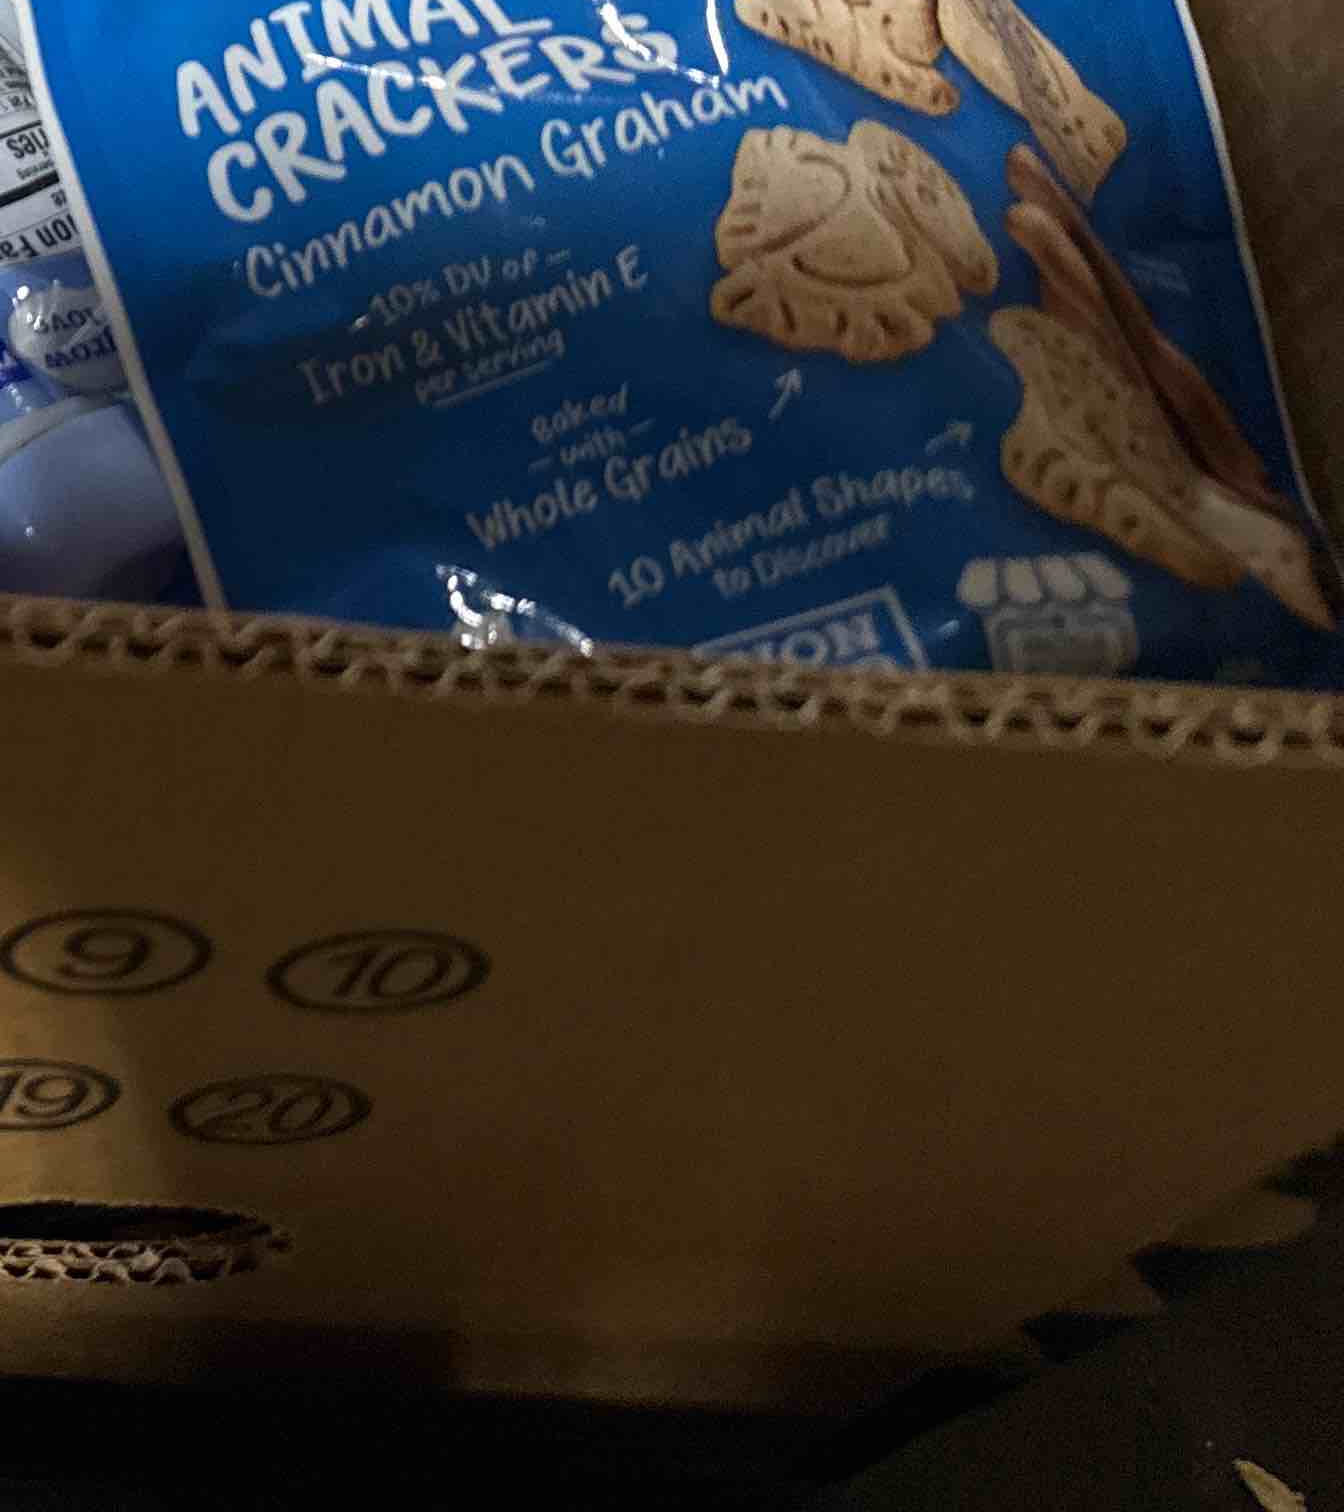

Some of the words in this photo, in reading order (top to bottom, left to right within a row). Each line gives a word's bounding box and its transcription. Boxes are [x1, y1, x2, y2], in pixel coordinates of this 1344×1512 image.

[206, 14, 678, 225] CRACKERS
[242, 145, 535, 298] Cinnamon
[541, 72, 788, 175] Graham
[298, 333, 405, 405] Iron
[411, 333, 444, 366] &
[444, 266, 609, 354] Vitamin
[616, 246, 650, 287] E
[441, 258, 491, 303] DV
[501, 248, 536, 282] of
[413, 370, 453, 406] per
[531, 382, 630, 446] Baked
[468, 480, 597, 550] Whole
[604, 417, 753, 500] Grains
[608, 557, 665, 609] 10
[670, 493, 806, 580] Animal
